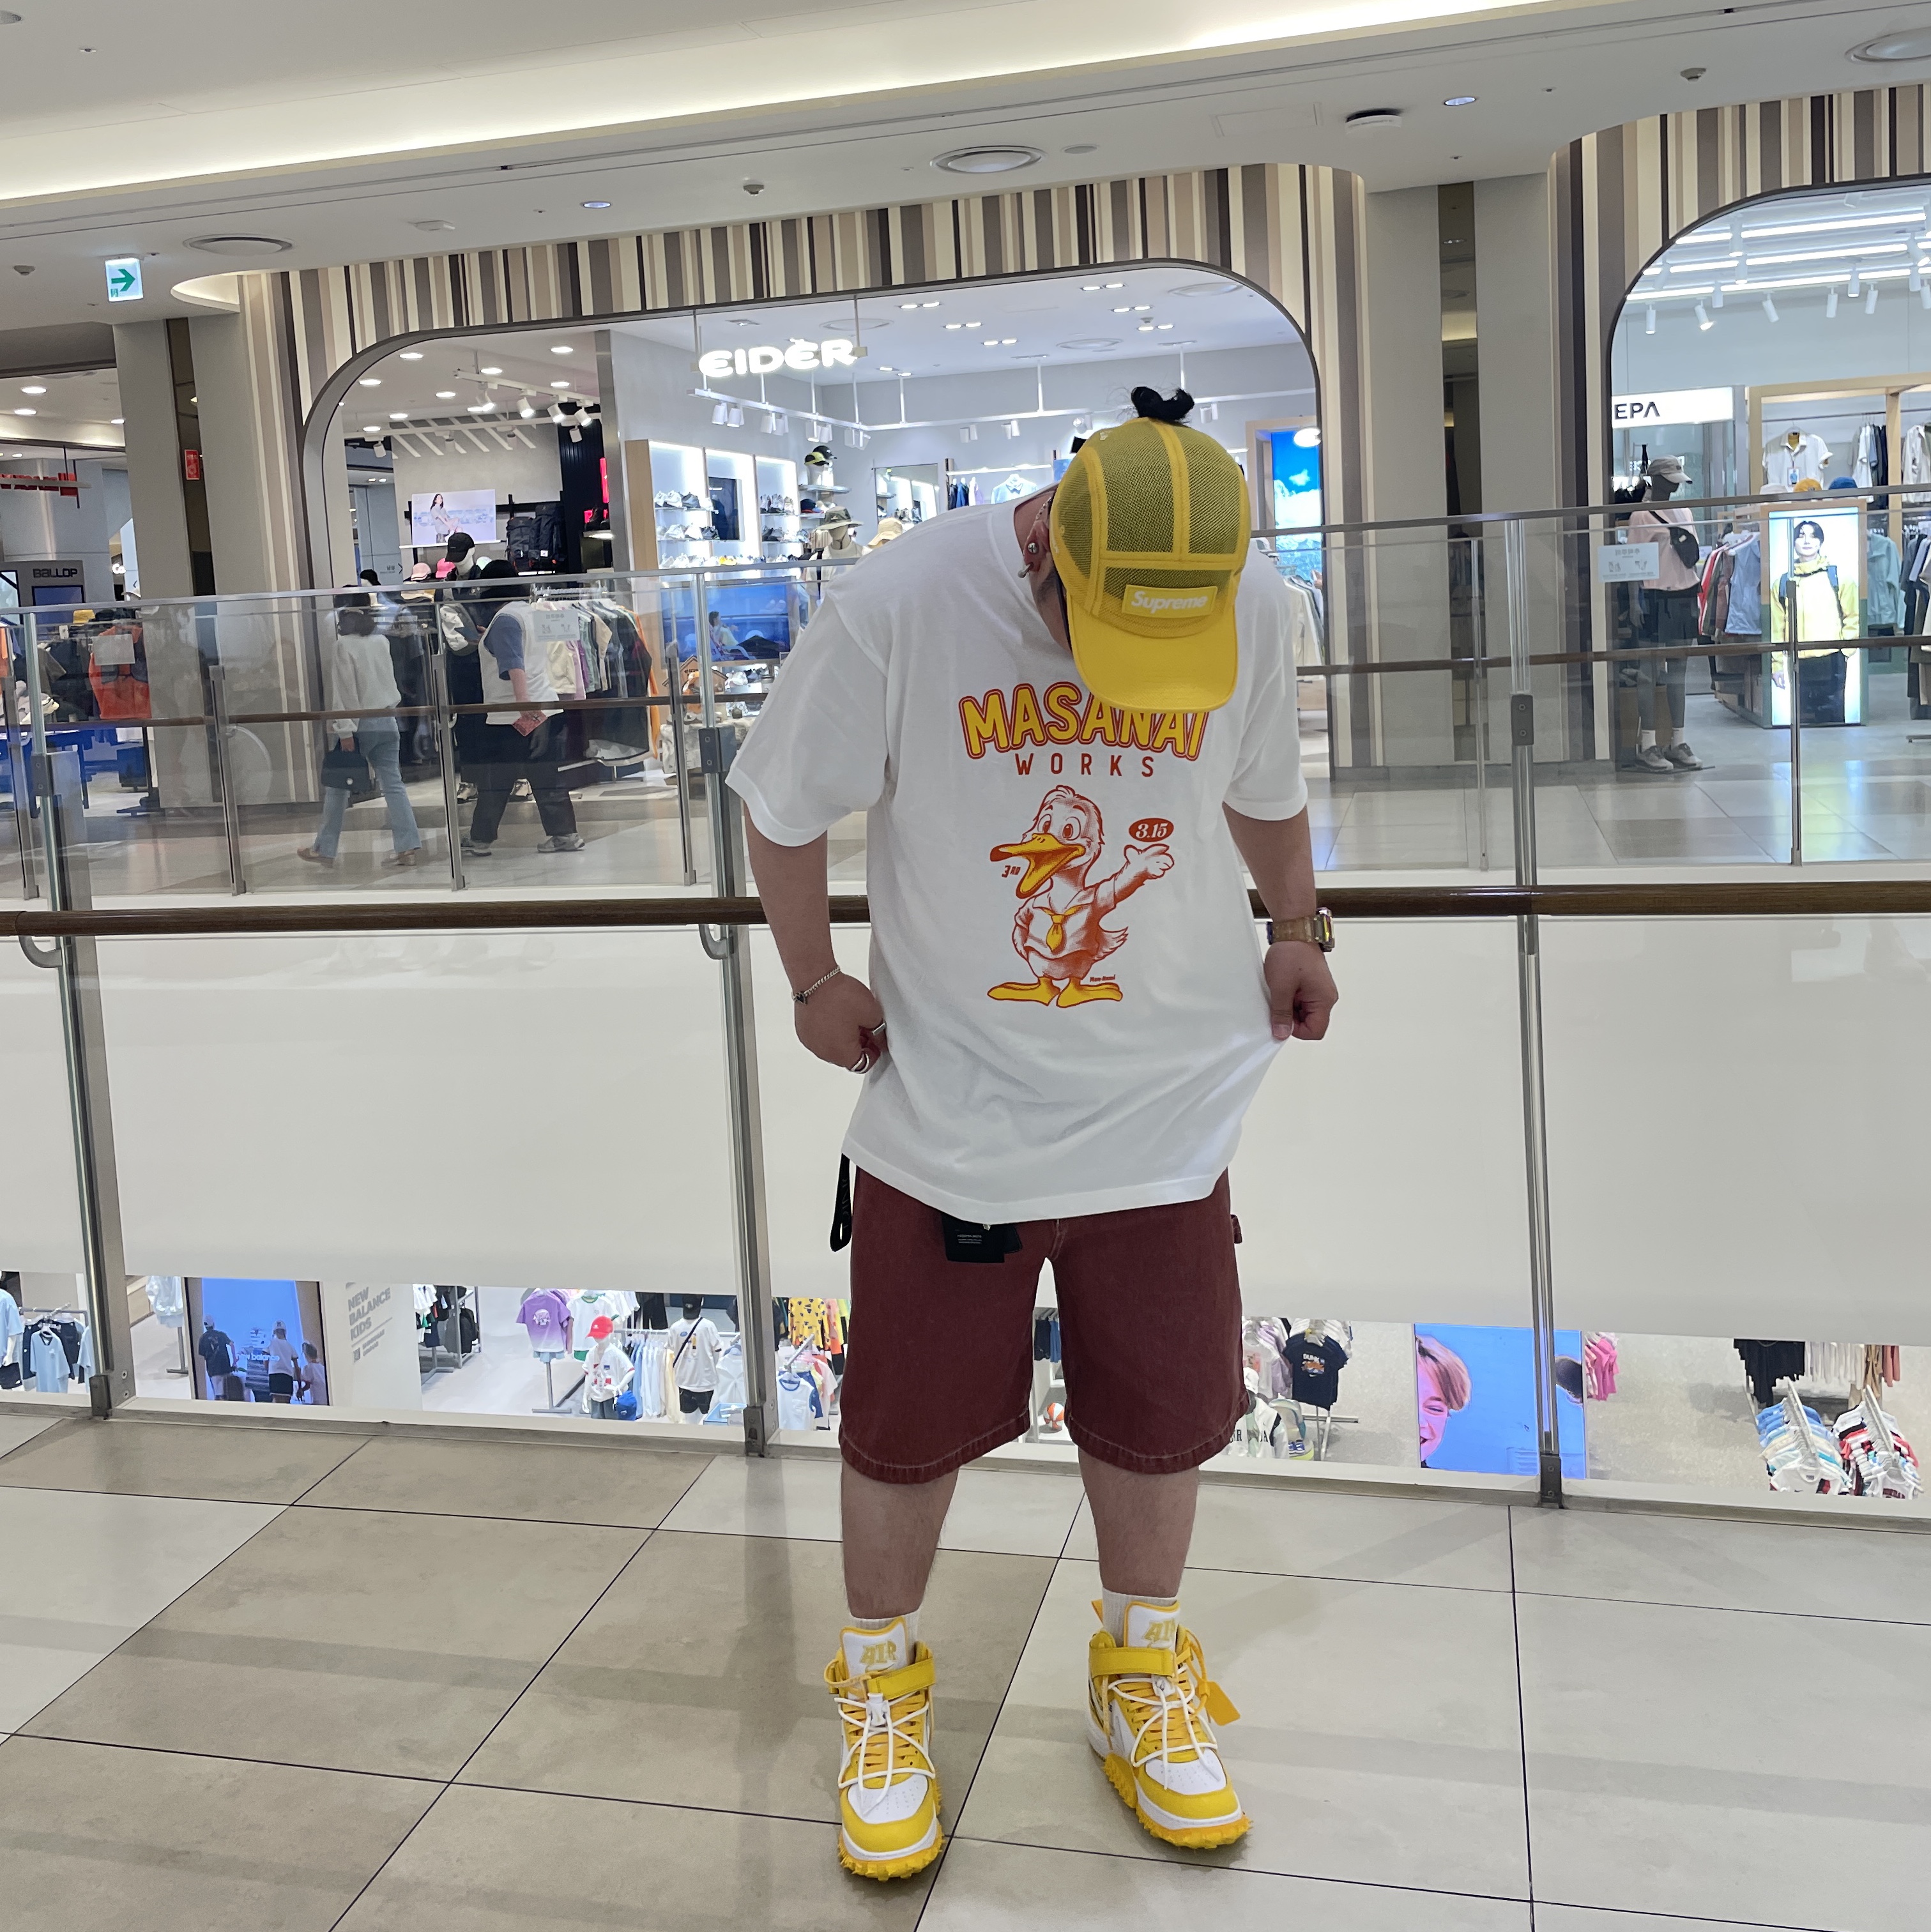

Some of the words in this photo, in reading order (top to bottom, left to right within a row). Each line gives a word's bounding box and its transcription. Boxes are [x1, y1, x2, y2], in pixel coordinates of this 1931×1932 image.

[699, 338, 858, 377] EIDER
[1131, 590, 1208, 614] Supreme
[1015, 752, 1154, 777] WORKS
[1135, 822, 1169, 839] 3.15
[348, 1286, 369, 1312] NEW
[349, 1287, 391, 1326] BALANCE
[350, 1316, 372, 1341] KIDS
[250, 1352, 280, 1361] balance
[860, 1639, 897, 1666] AIR
